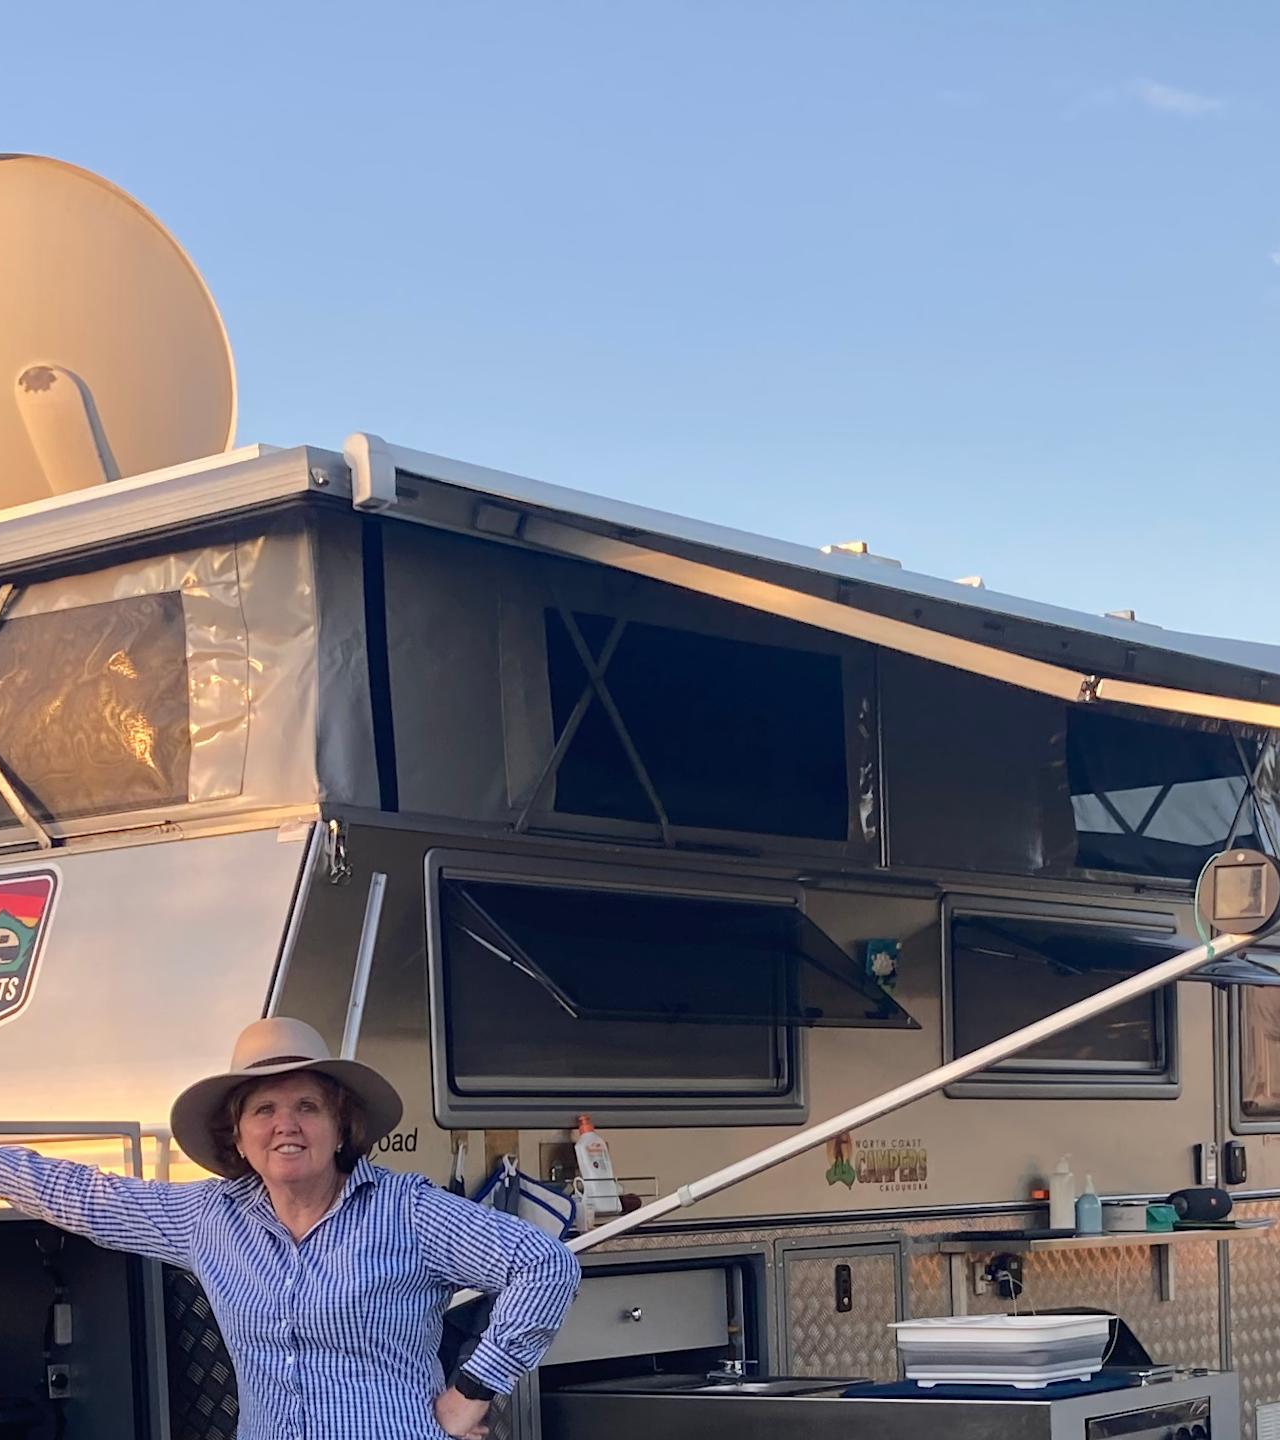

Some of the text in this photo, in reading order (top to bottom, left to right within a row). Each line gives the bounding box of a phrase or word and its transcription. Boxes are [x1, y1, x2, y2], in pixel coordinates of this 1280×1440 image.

[375, 1127, 418, 1155] oad
[855, 1139, 922, 1149] NORTH COAST
[855, 1148, 928, 1184] CAMPERS
